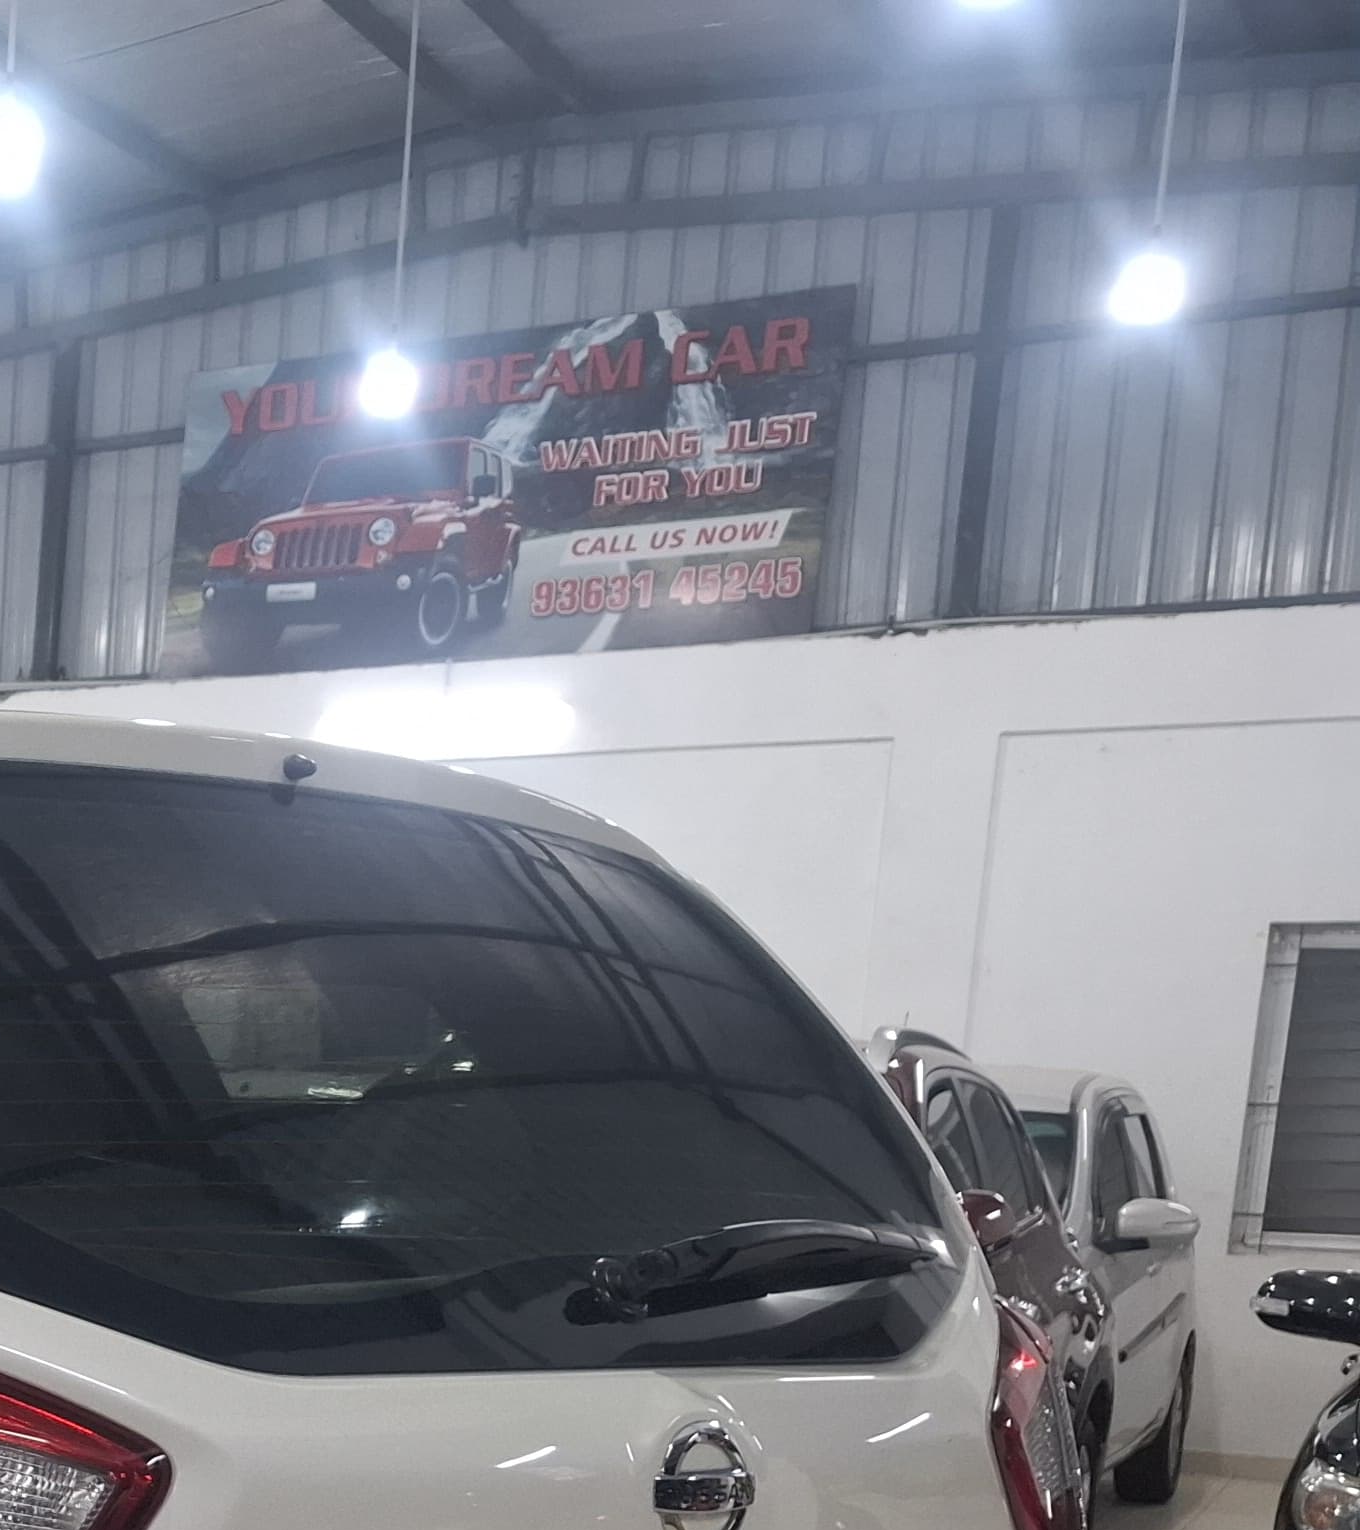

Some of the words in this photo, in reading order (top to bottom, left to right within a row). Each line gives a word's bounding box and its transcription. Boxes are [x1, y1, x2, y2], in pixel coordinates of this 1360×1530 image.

[221, 367, 365, 435] YOU
[670, 317, 810, 385] CAR
[539, 427, 702, 473] WAITING
[713, 411, 818, 451] JUST
[592, 469, 669, 507] FOR
[681, 459, 762, 497] YOU
[571, 534, 637, 557] CALL
[650, 529, 685, 550] US
[696, 520, 780, 546] NOW!
[531, 570, 654, 617] 93631
[669, 557, 802, 605] 45245
